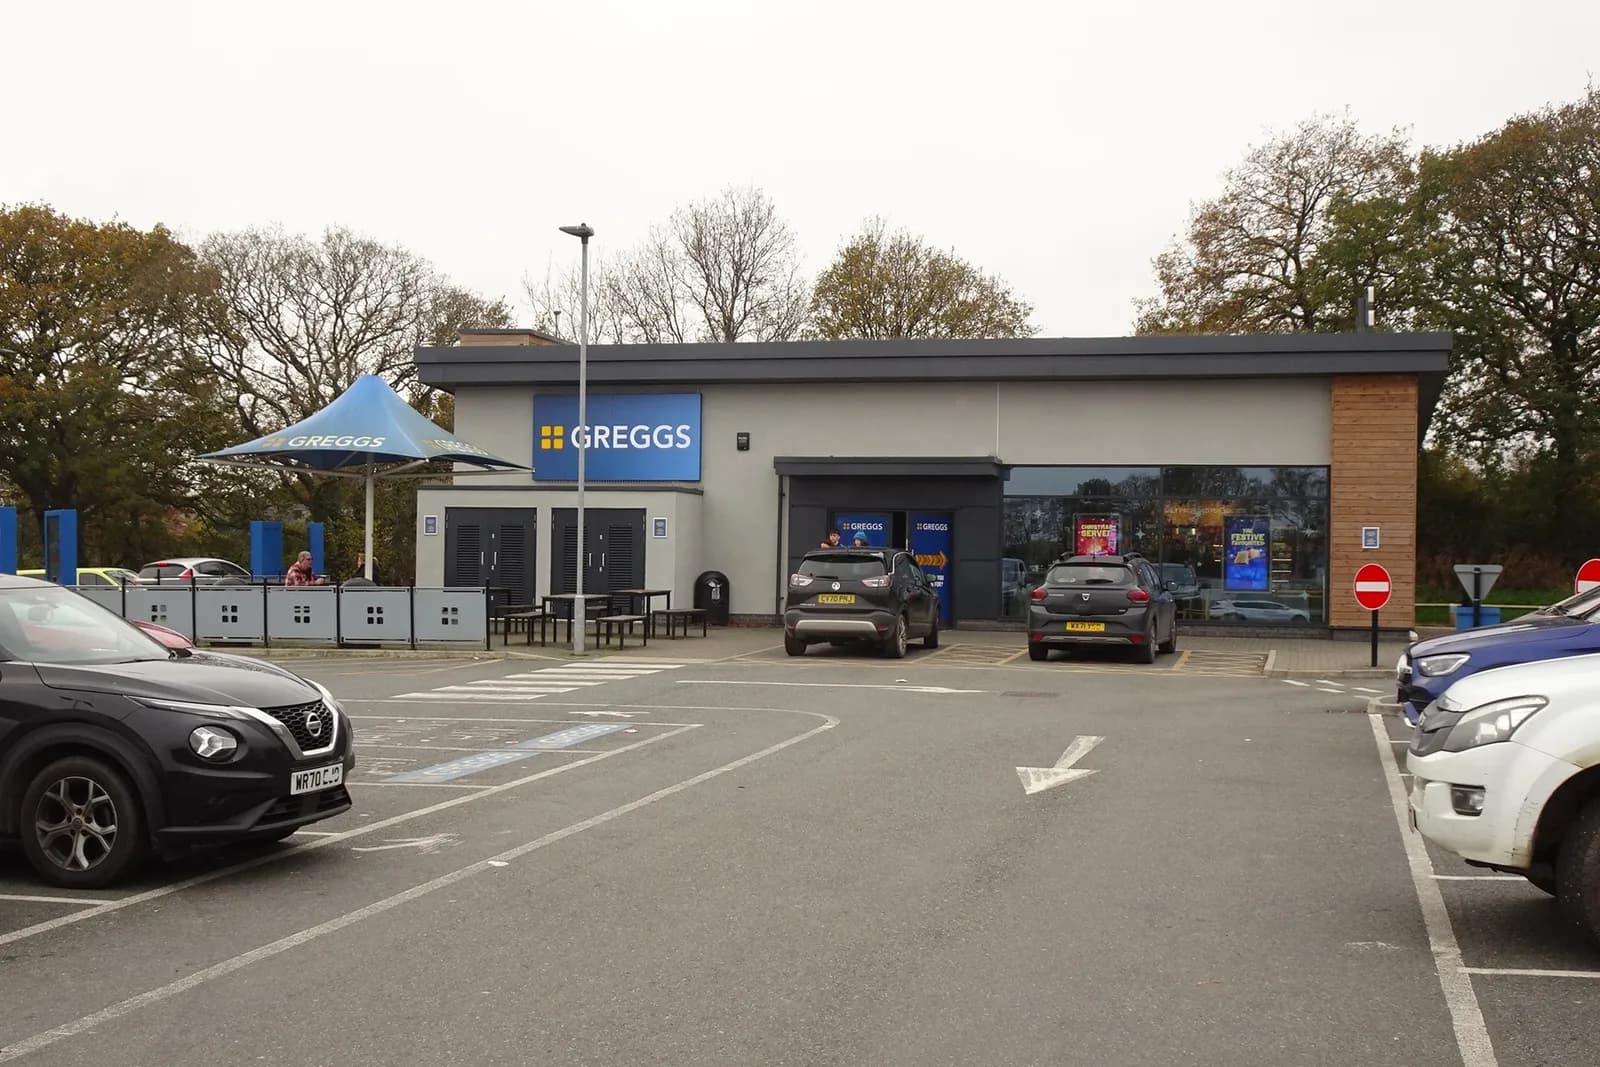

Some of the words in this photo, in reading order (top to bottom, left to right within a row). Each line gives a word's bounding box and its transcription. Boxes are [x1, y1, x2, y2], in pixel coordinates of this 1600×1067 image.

[287, 435, 386, 448] GREGGS
[571, 424, 691, 449] GREGGS
[850, 522, 883, 530] GREGGS
[922, 523, 948, 531] GREGGS
[1231, 533, 1265, 541] FESTIVE
[296, 770, 321, 791] WR70
